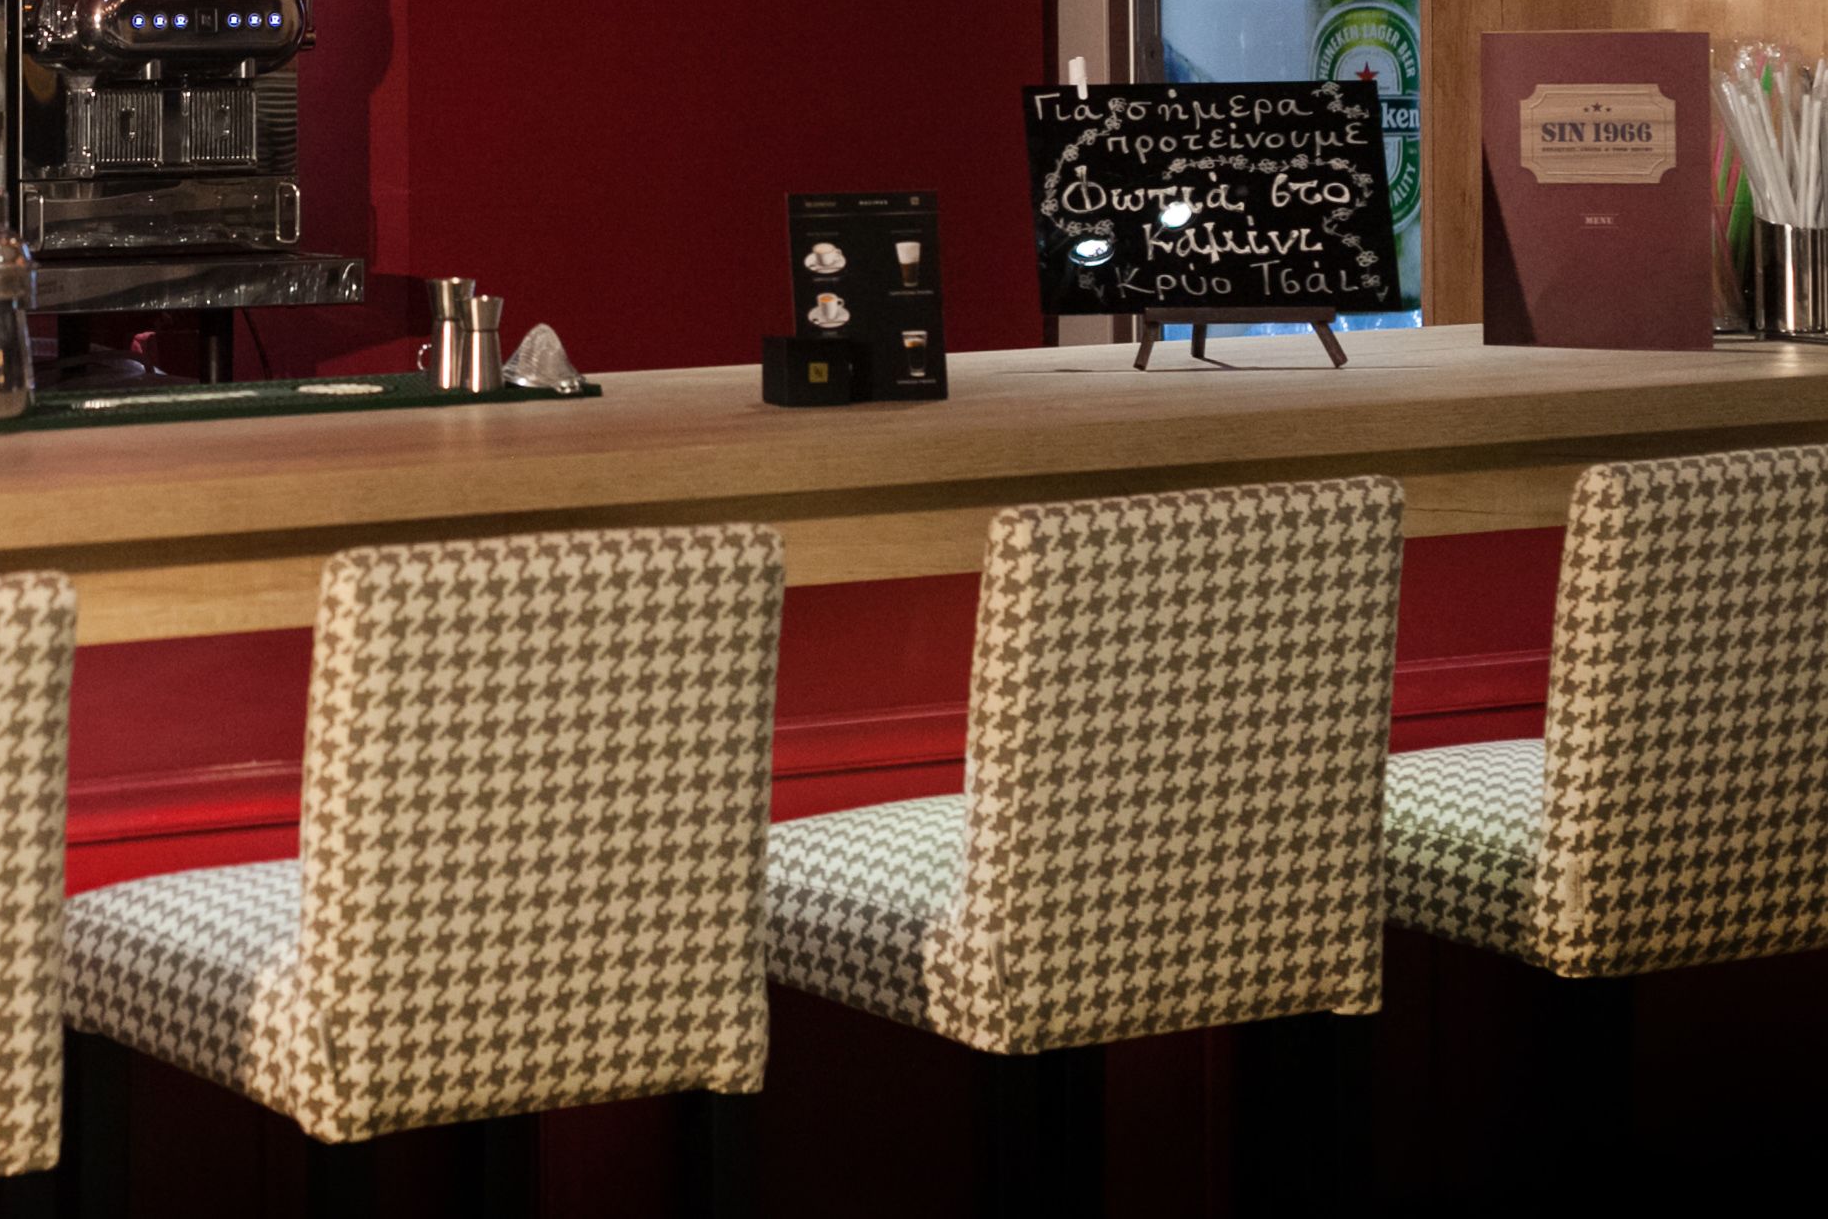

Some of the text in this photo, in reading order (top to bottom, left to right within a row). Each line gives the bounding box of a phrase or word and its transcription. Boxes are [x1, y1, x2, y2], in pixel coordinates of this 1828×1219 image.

[1398, 41, 1416, 79] BEER
[1541, 121, 1653, 143] SIN 1966
[1584, 216, 1614, 225] MENU
